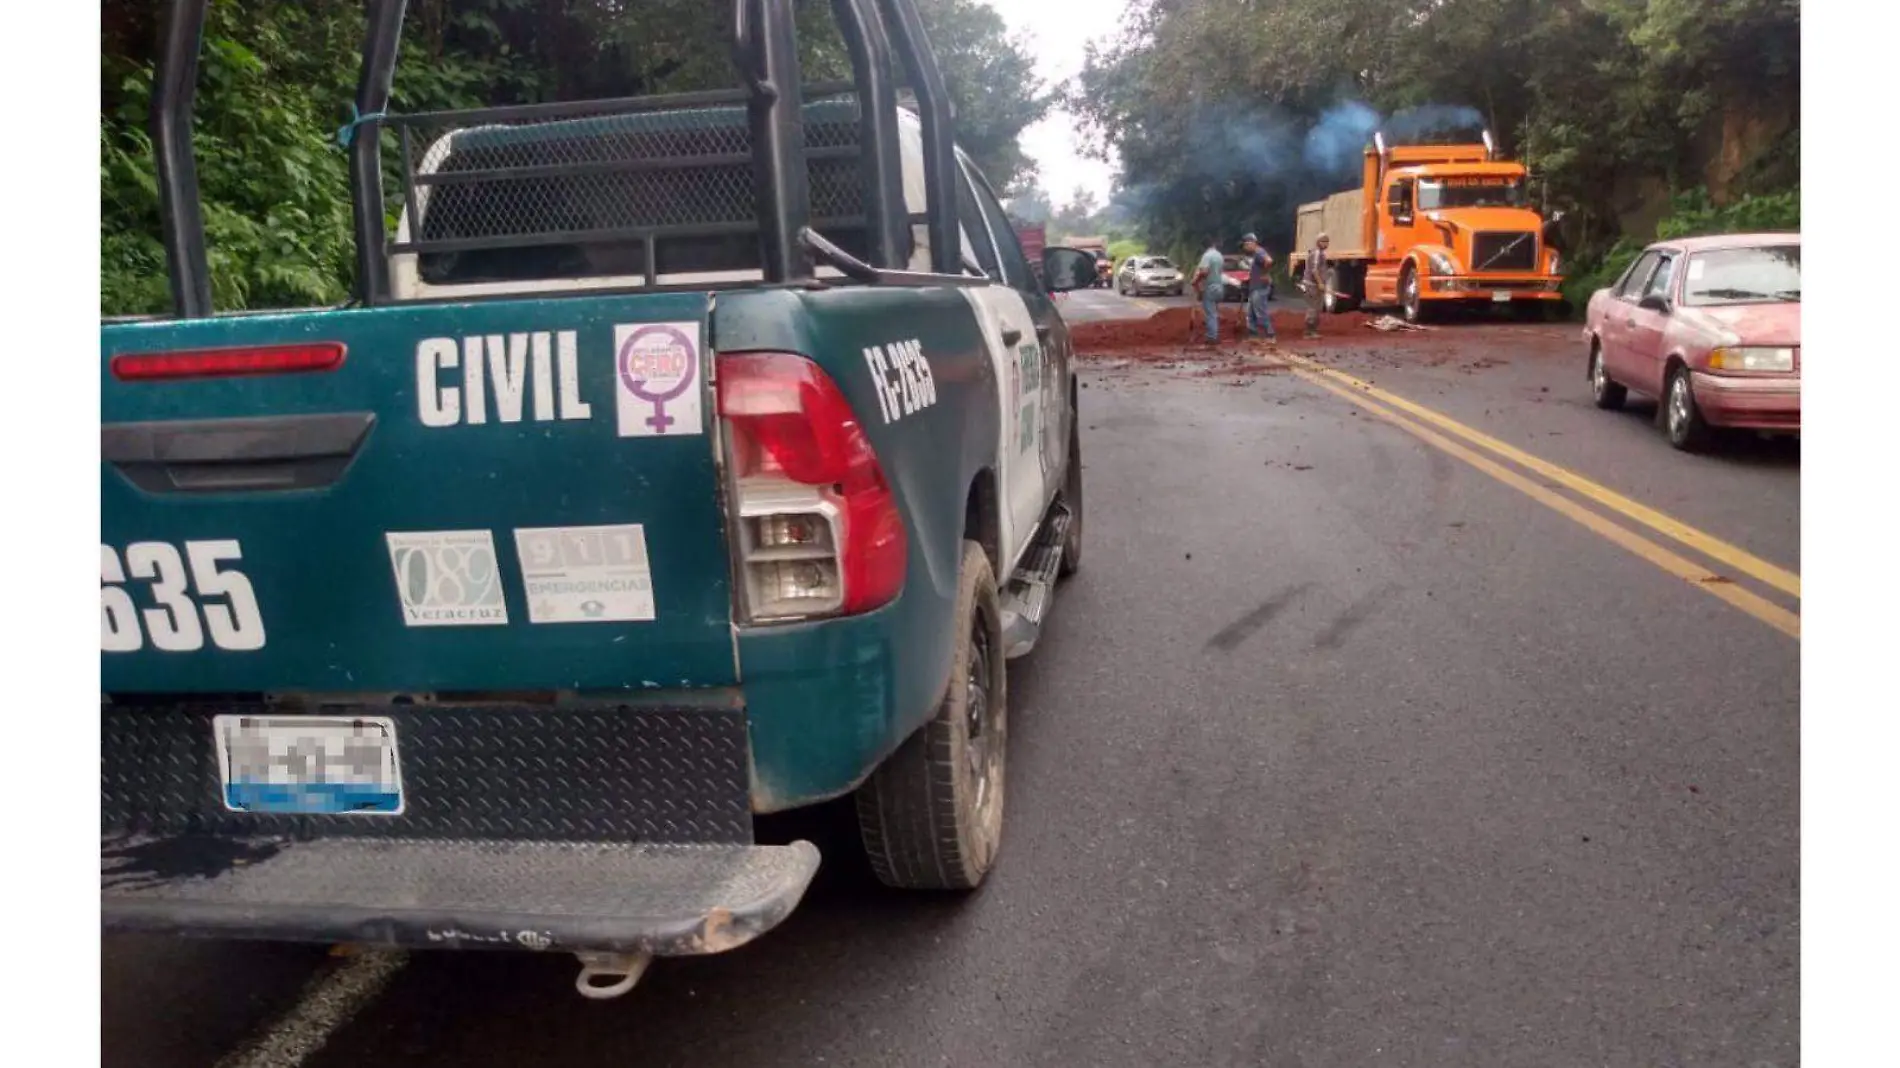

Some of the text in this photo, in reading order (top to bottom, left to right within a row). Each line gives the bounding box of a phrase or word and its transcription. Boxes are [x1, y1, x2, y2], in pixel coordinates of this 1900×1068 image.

[416, 330, 592, 427] CIVIL
[100, 539, 267, 652] 635
[401, 546, 496, 607] 089
[409, 607, 502, 620] Veracruz
